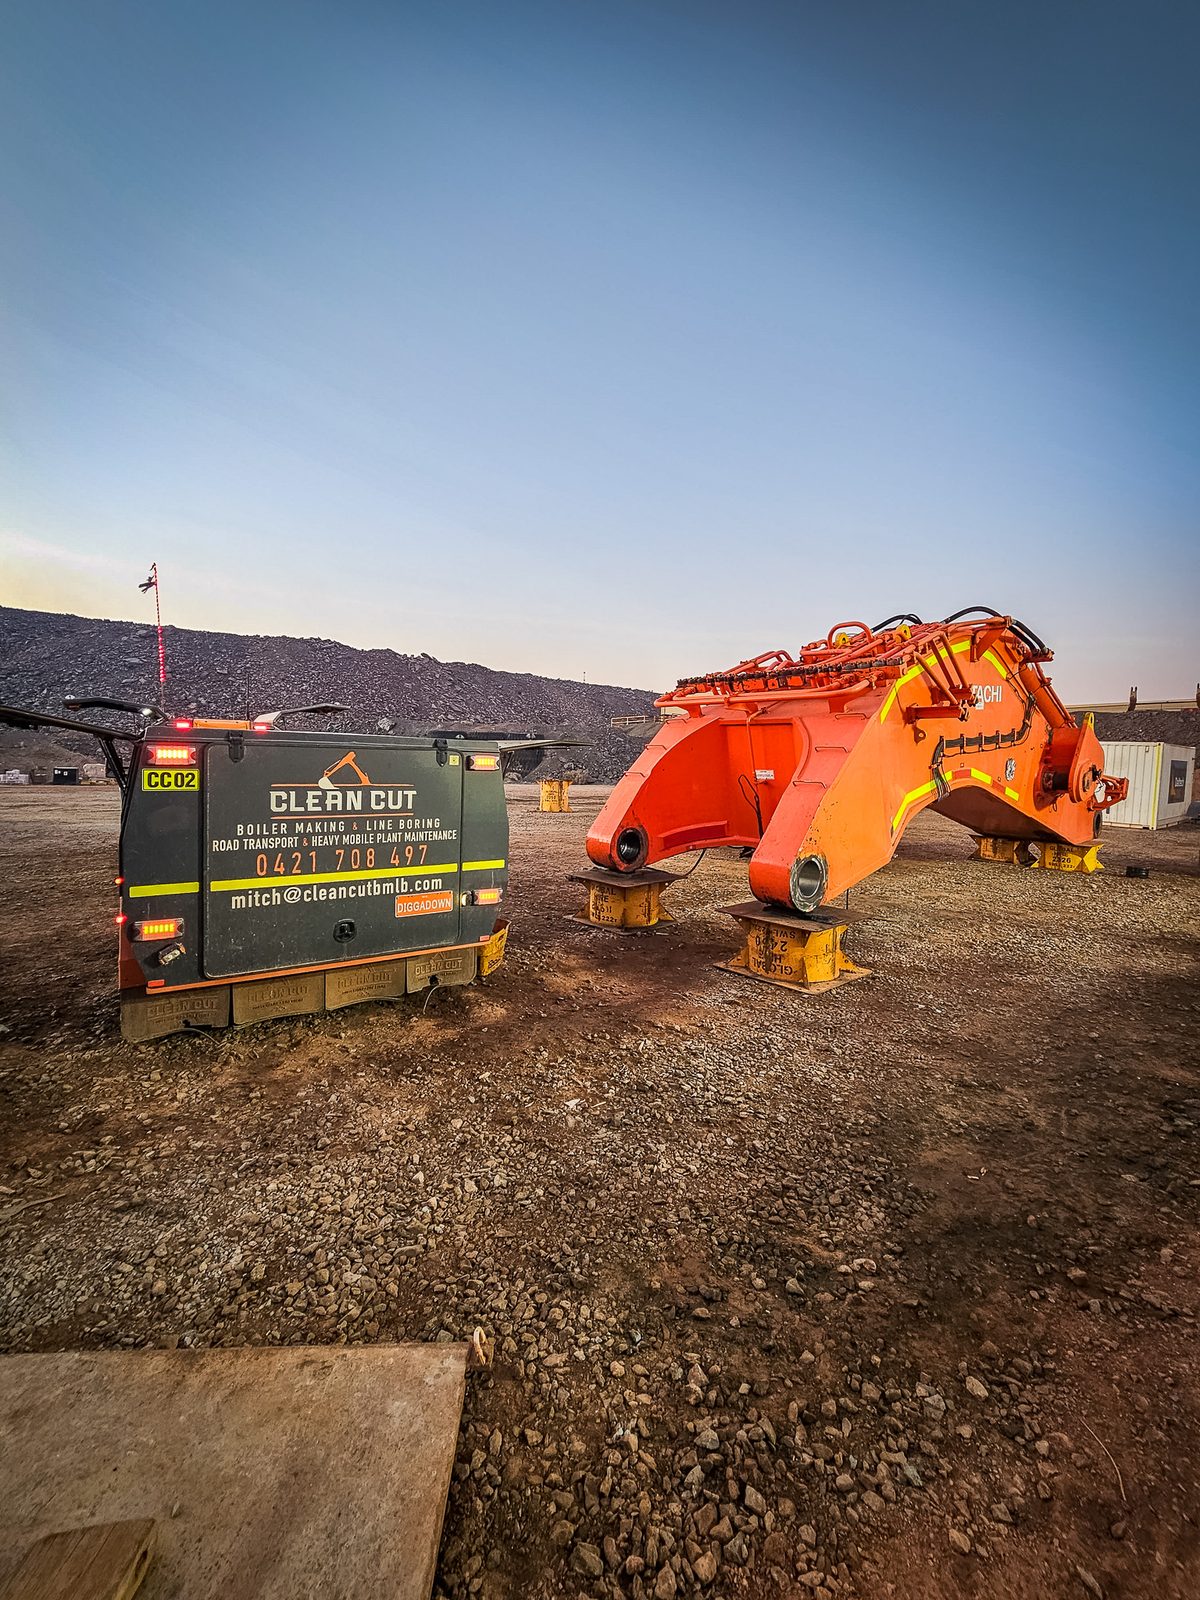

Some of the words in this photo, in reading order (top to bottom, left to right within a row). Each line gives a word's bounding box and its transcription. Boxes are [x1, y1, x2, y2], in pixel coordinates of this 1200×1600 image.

[971, 685, 1002, 703] TACHI
[269, 790, 362, 812] CLEAN
[370, 790, 417, 810] CUT
[236, 822, 288, 836] BOILER
[295, 820, 346, 834] MAKING
[352, 821, 358, 831] &
[366, 819, 393, 831] LINE
[399, 818, 441, 830] BORING
[212, 840, 240, 852] ROAD
[243, 836, 299, 850] TRANSPORT
[302, 837, 309, 847] &
[311, 834, 340, 847] HEAVY
[342, 832, 374, 845] MOBILE
[376, 831, 402, 844] PLANT
[404, 830, 457, 843] MAINTENANCE
[256, 850, 317, 876] 0421
[335, 847, 375, 870] 708
[390, 844, 428, 867] 497
[231, 878, 443, 910] mitch@cleancutbmlb.com
[397, 897, 451, 913] DIGGADOWN
